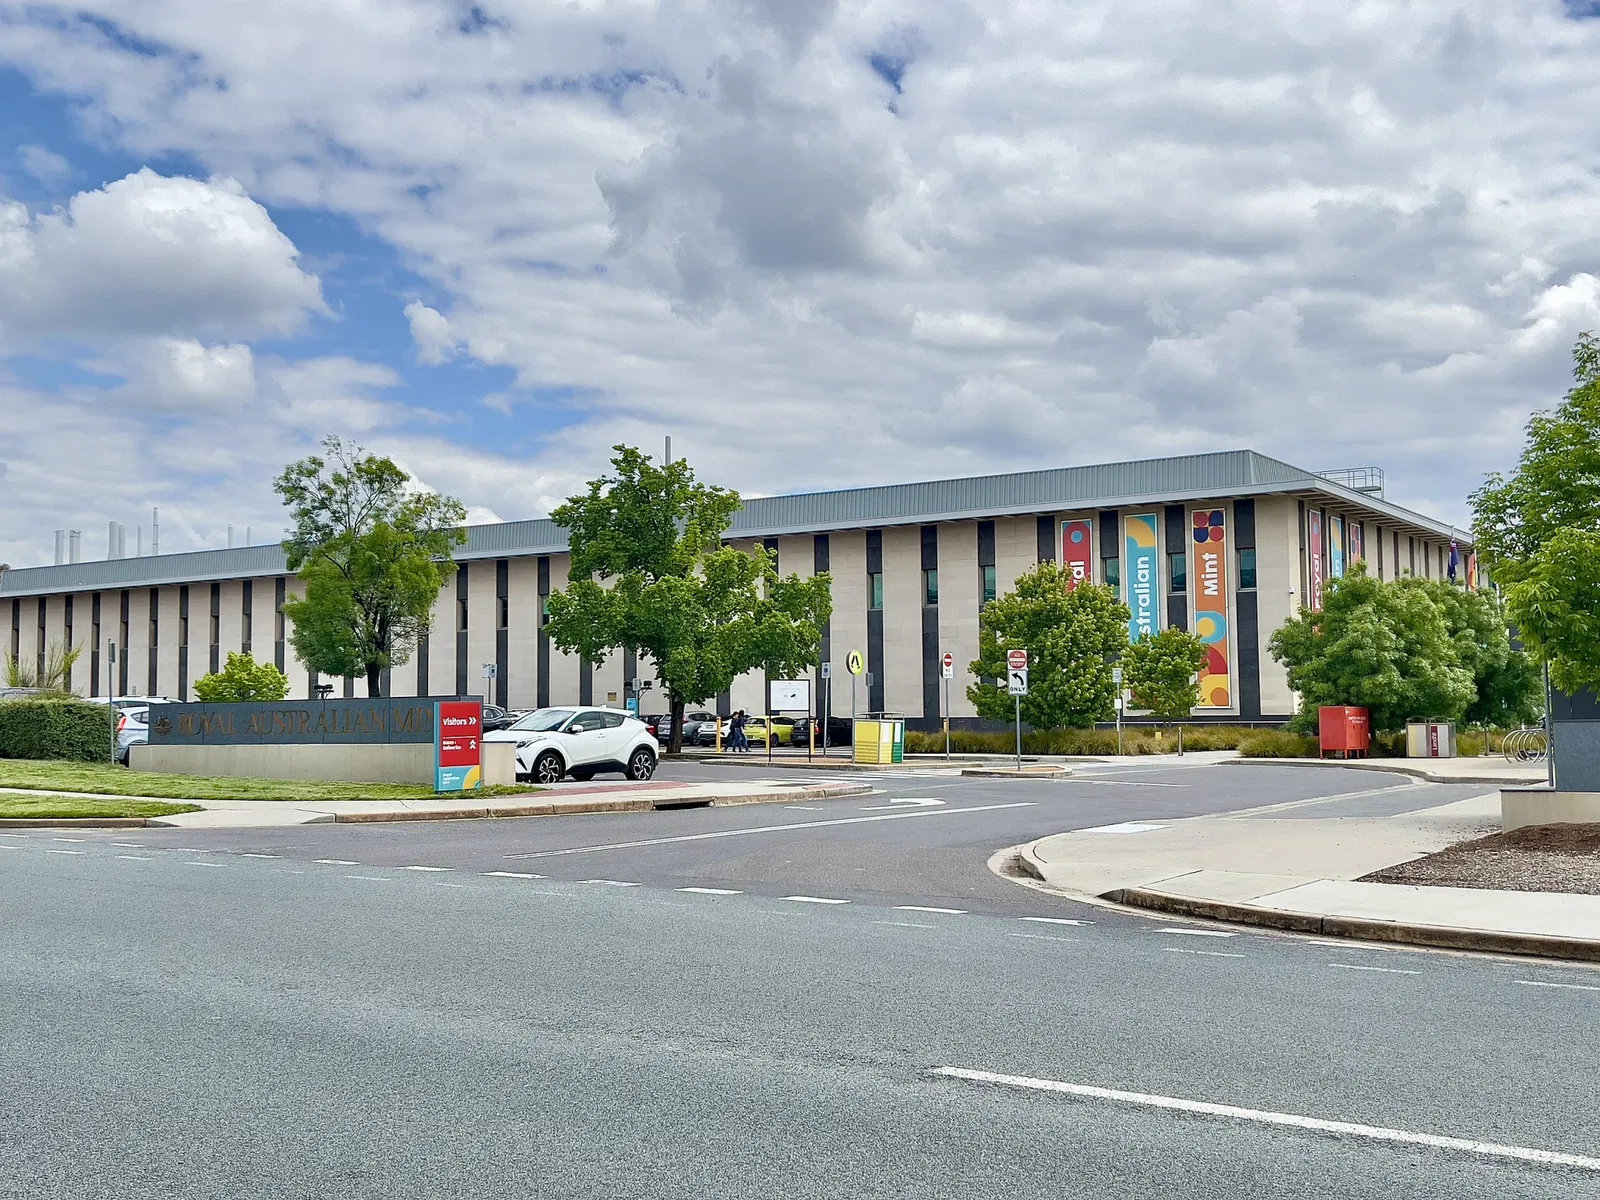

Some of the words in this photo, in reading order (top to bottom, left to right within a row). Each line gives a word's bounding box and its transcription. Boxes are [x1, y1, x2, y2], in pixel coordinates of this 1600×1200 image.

[1201, 552, 1218, 596] Mint
[177, 711, 240, 736] ROYAL
[244, 708, 387, 735] AUSTRALIAN
[442, 717, 467, 726] Visitors
